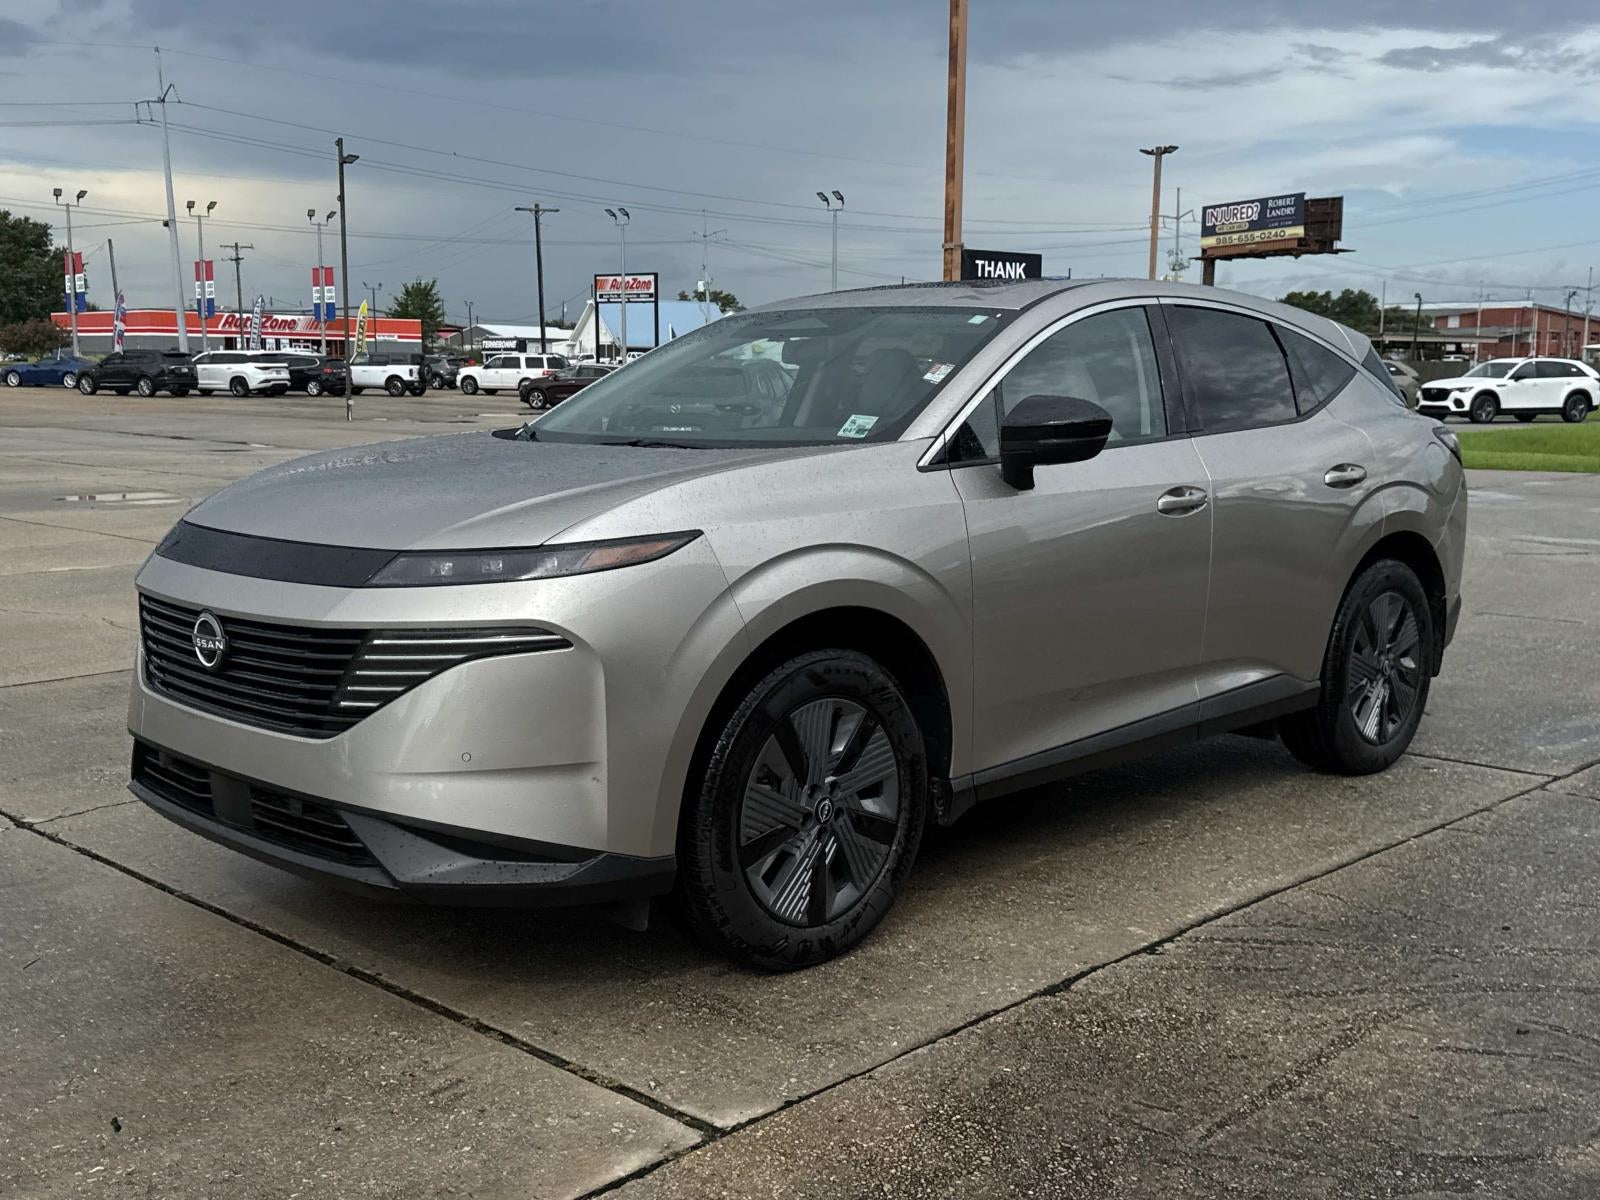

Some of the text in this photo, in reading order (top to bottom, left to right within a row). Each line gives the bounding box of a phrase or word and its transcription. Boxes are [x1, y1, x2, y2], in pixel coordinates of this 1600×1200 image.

[1267, 197, 1296, 208] ROBERT
[1206, 202, 1260, 226] INJURED?
[1266, 206, 1296, 218] LANDRY
[1215, 230, 1286, 245] 985-655-0240
[975, 259, 1026, 279] THANK
[609, 277, 653, 290] AuoZone
[222, 314, 298, 330] AutZone
[195, 638, 224, 650] SSAN
